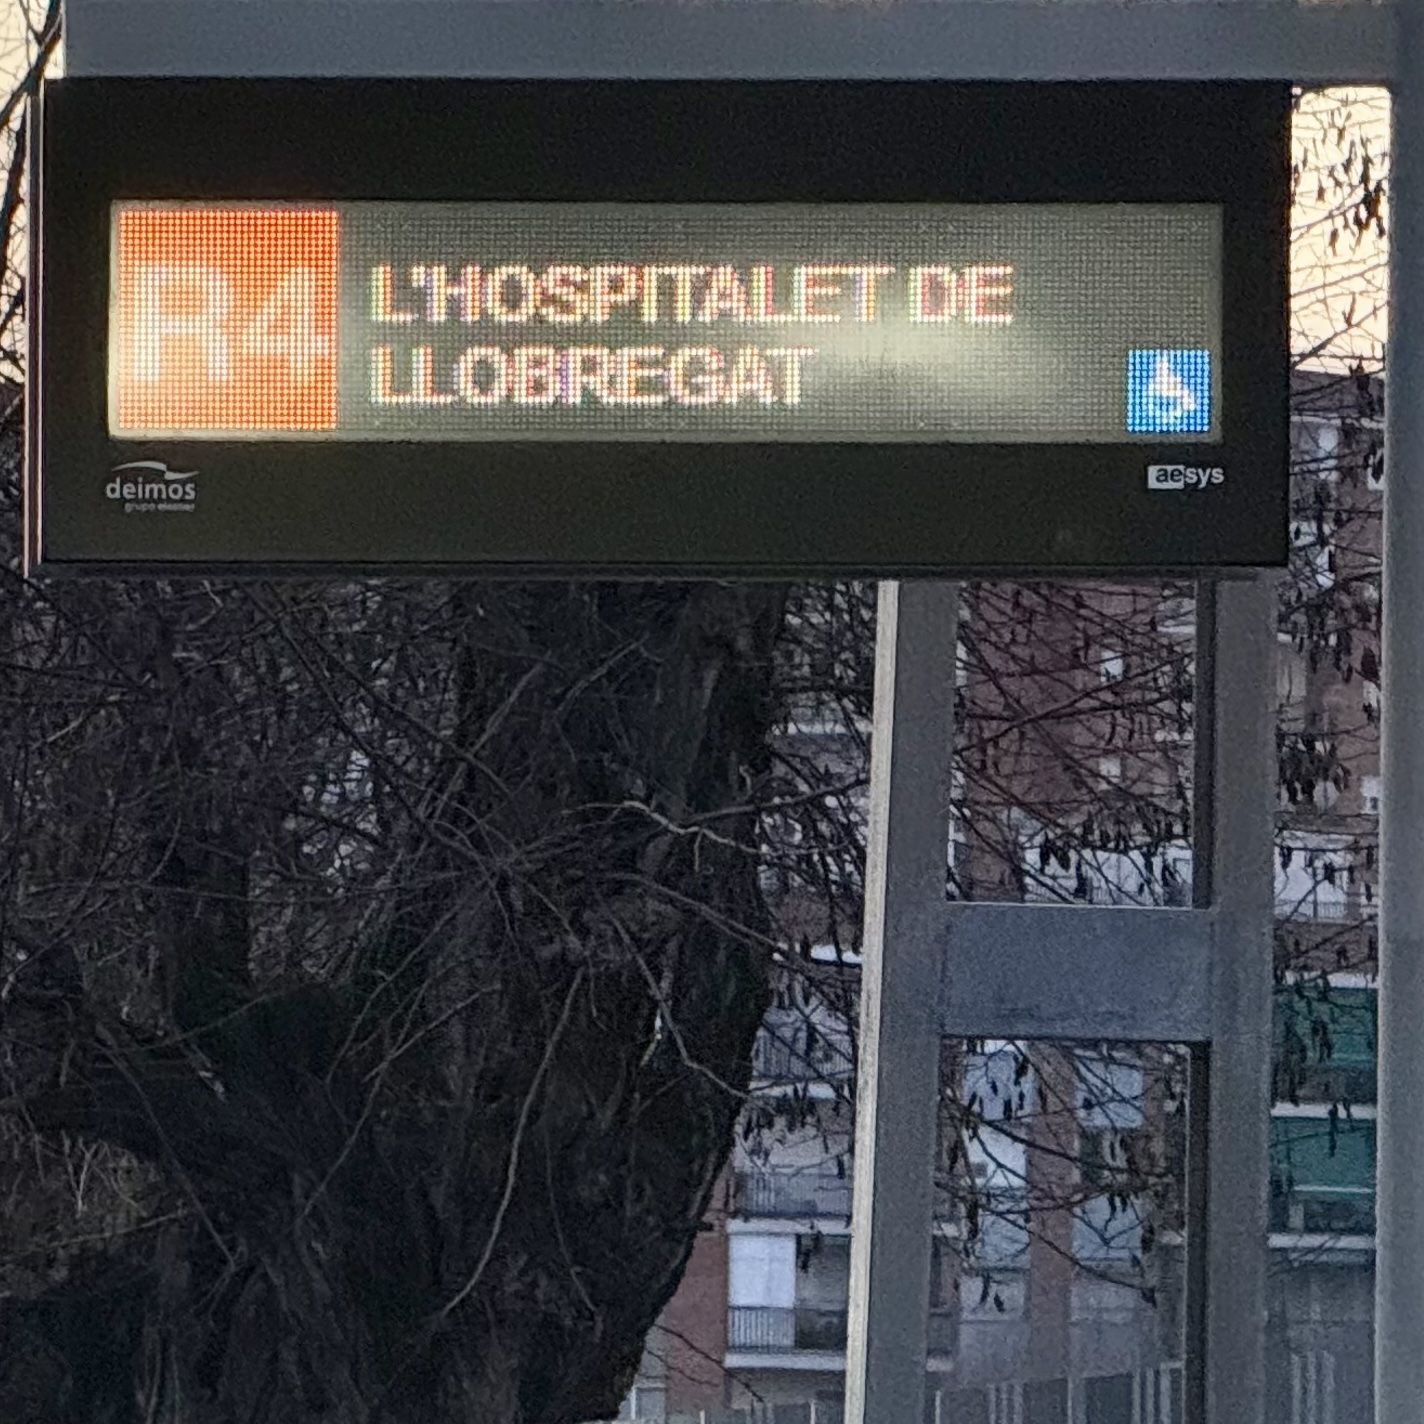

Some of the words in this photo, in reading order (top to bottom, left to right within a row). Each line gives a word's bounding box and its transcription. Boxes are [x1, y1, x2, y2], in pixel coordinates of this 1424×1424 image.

[370, 264, 896, 323] L'HOSPITALET
[910, 264, 1013, 323] DE
[132, 263, 330, 385] R4
[370, 345, 818, 404] LLOBREGAT
[106, 476, 196, 500] deimos
[1153, 466, 1225, 489] aesys
